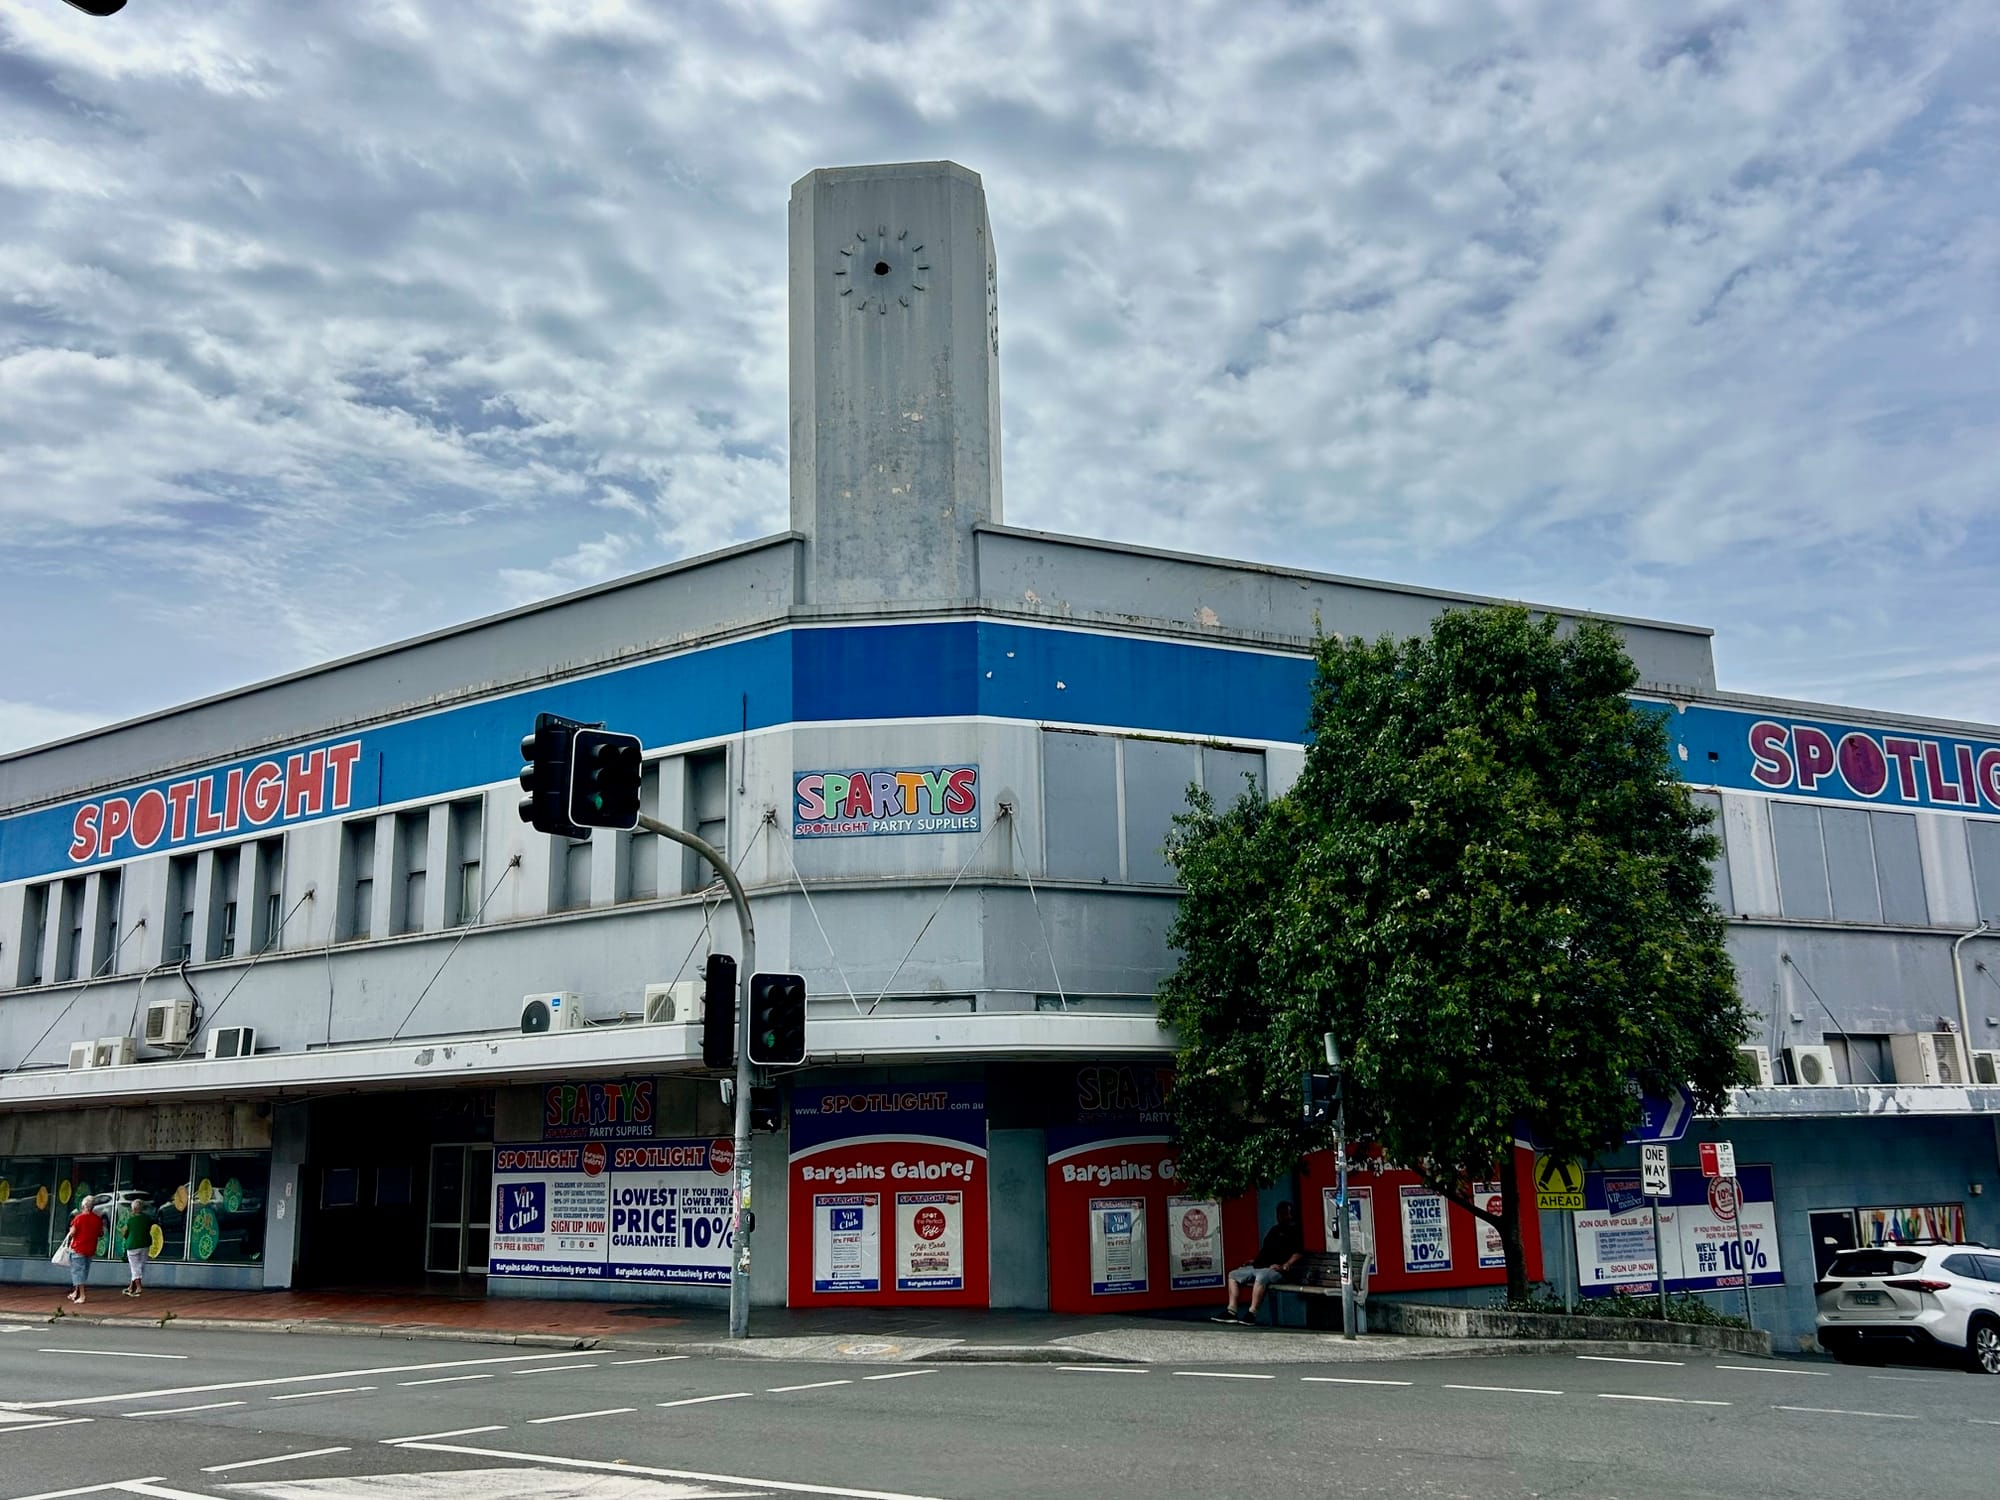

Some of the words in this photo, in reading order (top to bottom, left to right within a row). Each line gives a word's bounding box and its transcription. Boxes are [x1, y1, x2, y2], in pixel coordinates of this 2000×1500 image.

[796, 767, 976, 821] SPARTYS
[69, 739, 362, 863] SPOTLIGHT
[795, 822, 869, 835] SPOTLIGHT
[873, 819, 913, 832] PARTY
[917, 816, 978, 831] SUPPLIES
[1076, 1066, 1176, 1111] SPART
[546, 1080, 653, 1126] SPARTYS
[794, 1107, 820, 1116] www.
[820, 1091, 948, 1114] SPOTLIGHT
[1139, 1112, 1171, 1123] PARTY
[589, 1125, 614, 1138] PARTY
[616, 1124, 654, 1137] SUPPLIES
[1645, 1148, 1665, 1162] ONE
[1719, 1144, 1729, 1153] 1P
[496, 1148, 580, 1170] SPOTLIGHT
[614, 1146, 706, 1168] SPOTLIGHT
[801, 1161, 886, 1185] Bargains
[890, 1159, 974, 1183] Galore!
[1062, 1159, 1152, 1187] Bargains
[1644, 1165, 1666, 1177] WAY
[613, 1188, 677, 1206] LOWEST
[682, 1188, 689, 1196] IF
[692, 1188, 708, 1196] YOU
[710, 1188, 729, 1196] FIND
[682, 1197, 711, 1206] LOWER
[714, 1197, 733, 1207] PRIC
[1407, 1198, 1440, 1207] LOWEST
[1539, 1195, 1581, 1207] AHEAD
[682, 1207, 701, 1215] WE'LL
[703, 1207, 719, 1215] BEAT
[720, 1207, 726, 1215] IT
[1409, 1207, 1441, 1219] PRICE
[508, 1206, 539, 1231] Club
[612, 1208, 677, 1234] PRICE
[839, 1218, 859, 1230] Club
[1578, 1220, 1593, 1228] JOIN
[1594, 1219, 1608, 1228] OUR
[1609, 1219, 1620, 1227] VIP
[1620, 1217, 1638, 1226] CLUB
[551, 1220, 569, 1233] SIGN
[573, 1220, 583, 1232] UP
[586, 1221, 606, 1233] NOW
[682, 1216, 733, 1249] 10%
[494, 1242, 503, 1251] IT'S
[504, 1242, 516, 1251] FREE
[517, 1243, 521, 1251] &
[522, 1243, 545, 1252] INSTANT!
[612, 1234, 676, 1248] GUARANTEE
[1696, 1242, 1717, 1253] WE'LL
[1411, 1243, 1444, 1261] 10%
[1699, 1252, 1716, 1262] BEAT
[1719, 1238, 1767, 1270] 10%
[496, 1263, 521, 1274] Bargains
[542, 1265, 575, 1275] Exclusively
[576, 1266, 586, 1275] For
[587, 1266, 602, 1276] You!
[615, 1267, 642, 1278] Bargains
[666, 1269, 702, 1280] Exclusively
[703, 1271, 715, 1280] For
[1610, 1264, 1626, 1273] SIGN
[1627, 1264, 1637, 1272] UP
[1638, 1262, 1654, 1271] NOW
[1699, 1263, 1706, 1273] IT
[1708, 1262, 1717, 1272] BY
